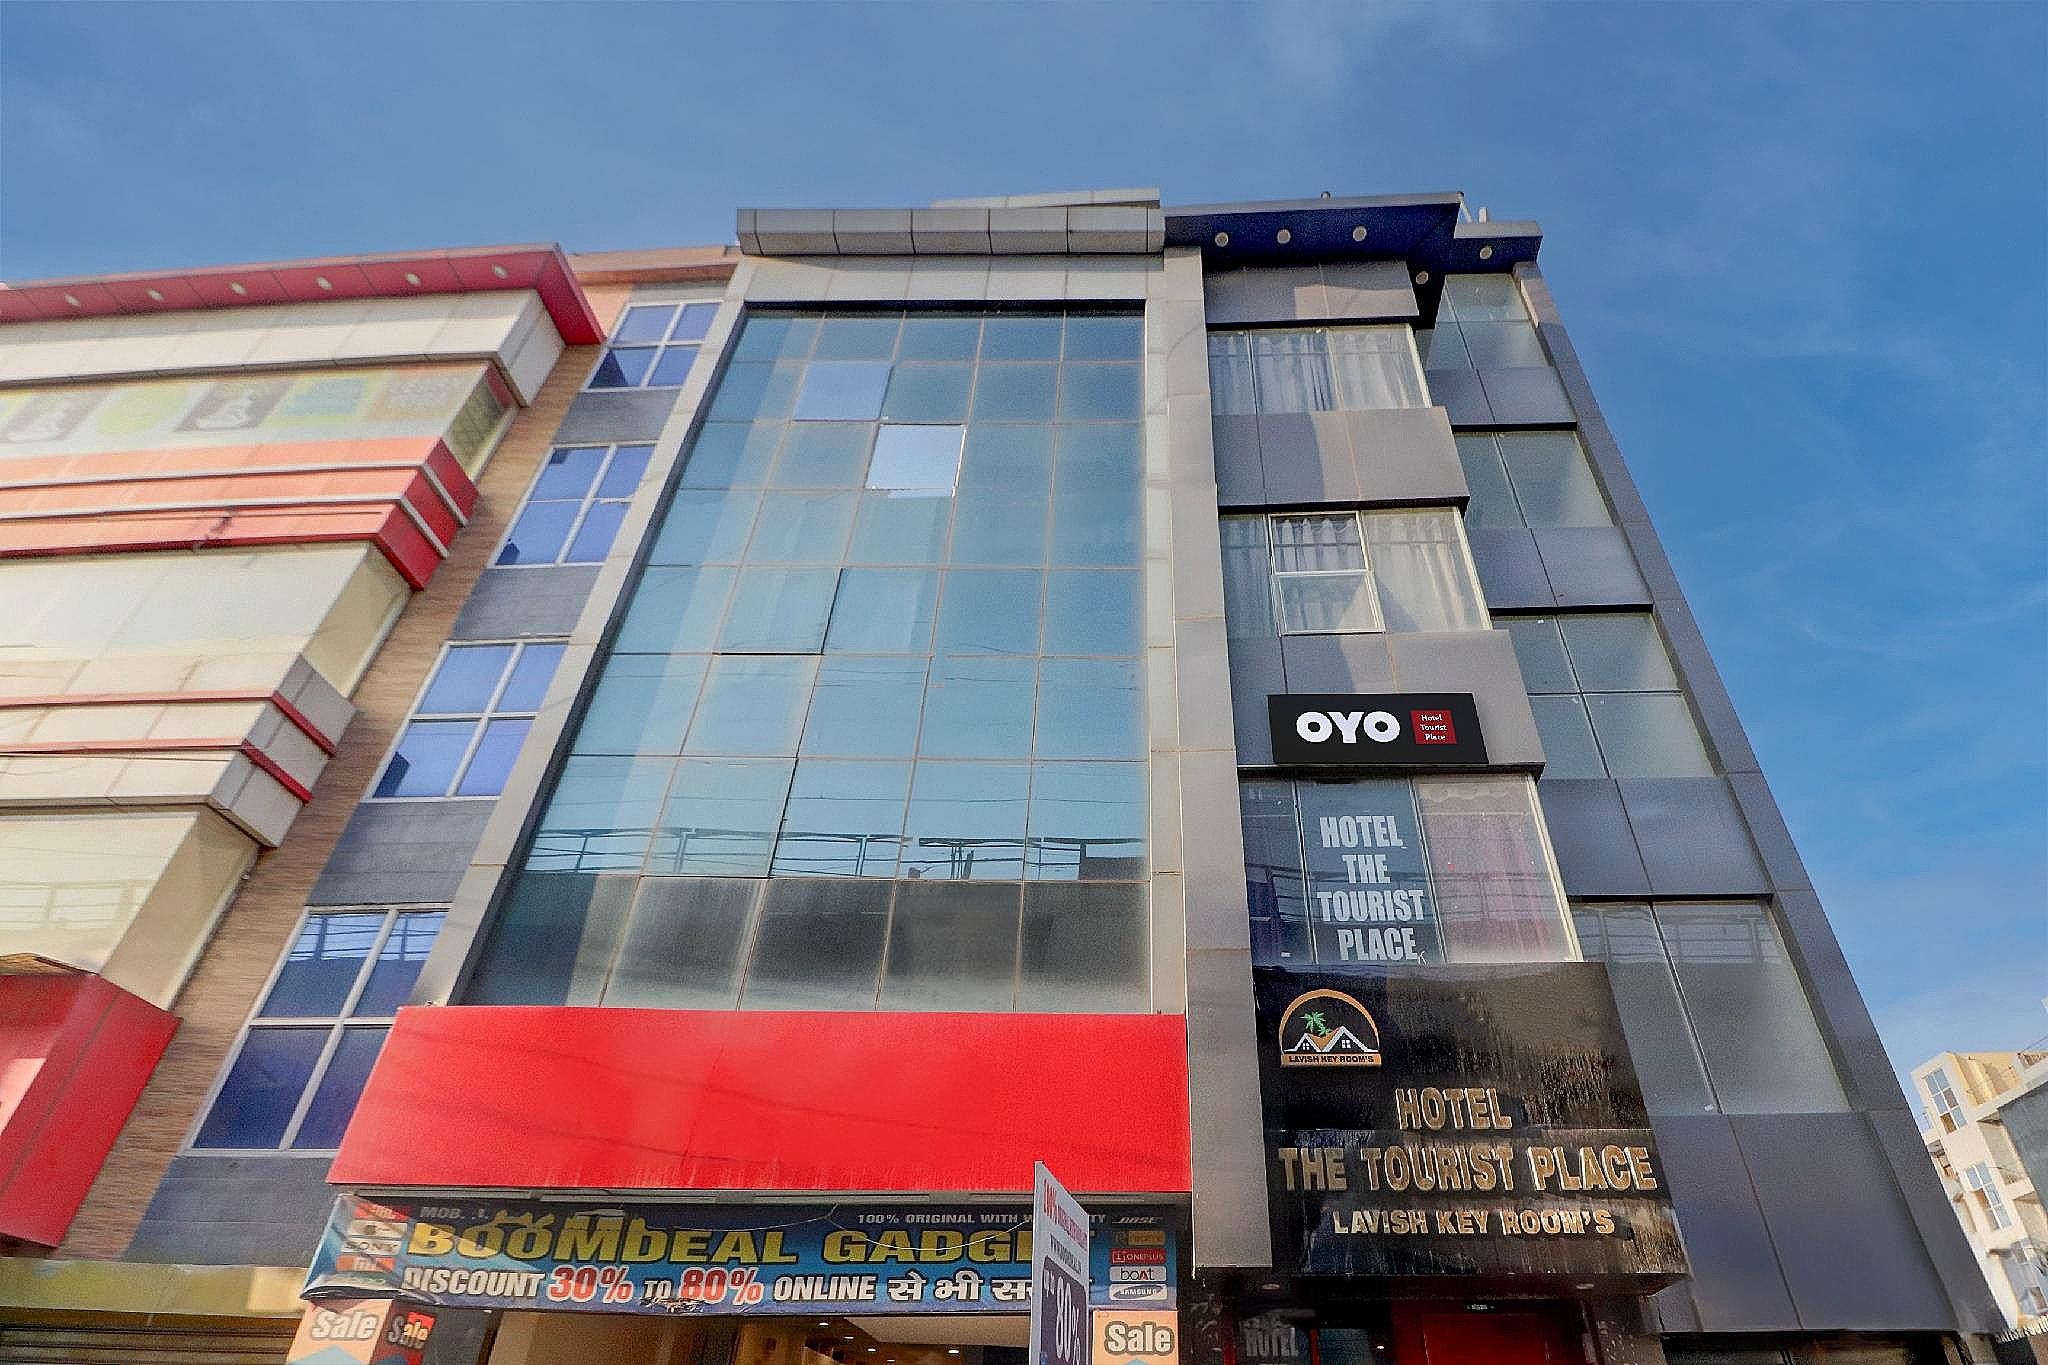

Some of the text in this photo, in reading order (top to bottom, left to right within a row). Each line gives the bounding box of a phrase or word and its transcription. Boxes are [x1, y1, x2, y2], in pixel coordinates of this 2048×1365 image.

[1296, 711, 1401, 743] OYO
[1319, 815, 1405, 848] HOTEL
[1342, 854, 1392, 884] THE
[1316, 889, 1424, 922] TOURIST
[1336, 928, 1419, 961] PLACE
[1289, 1055, 1319, 1063] LAVISH
[1320, 1055, 1337, 1063] KEY
[1396, 1087, 1512, 1129] HOTEL
[1278, 1144, 1657, 1192] THE TOURIST PLACE
[858, 1214, 900, 1225] 100%
[905, 1214, 976, 1225] ORIGINAL
[980, 1214, 1018, 1224] WITH
[1333, 1209, 1615, 1235] LAVISH KEY ROOM'S
[345, 1240, 399, 1252] SONY
[402, 1267, 545, 1298] DISCOUNT
[549, 1266, 634, 1302] 30%
[679, 1266, 765, 1304] 80%
[773, 1275, 876, 1301] ONLINE
[888, 1271, 927, 1301] से
[935, 1270, 984, 1300] भी
[310, 1310, 377, 1340] Sale
[1107, 1323, 1173, 1354] Sale
